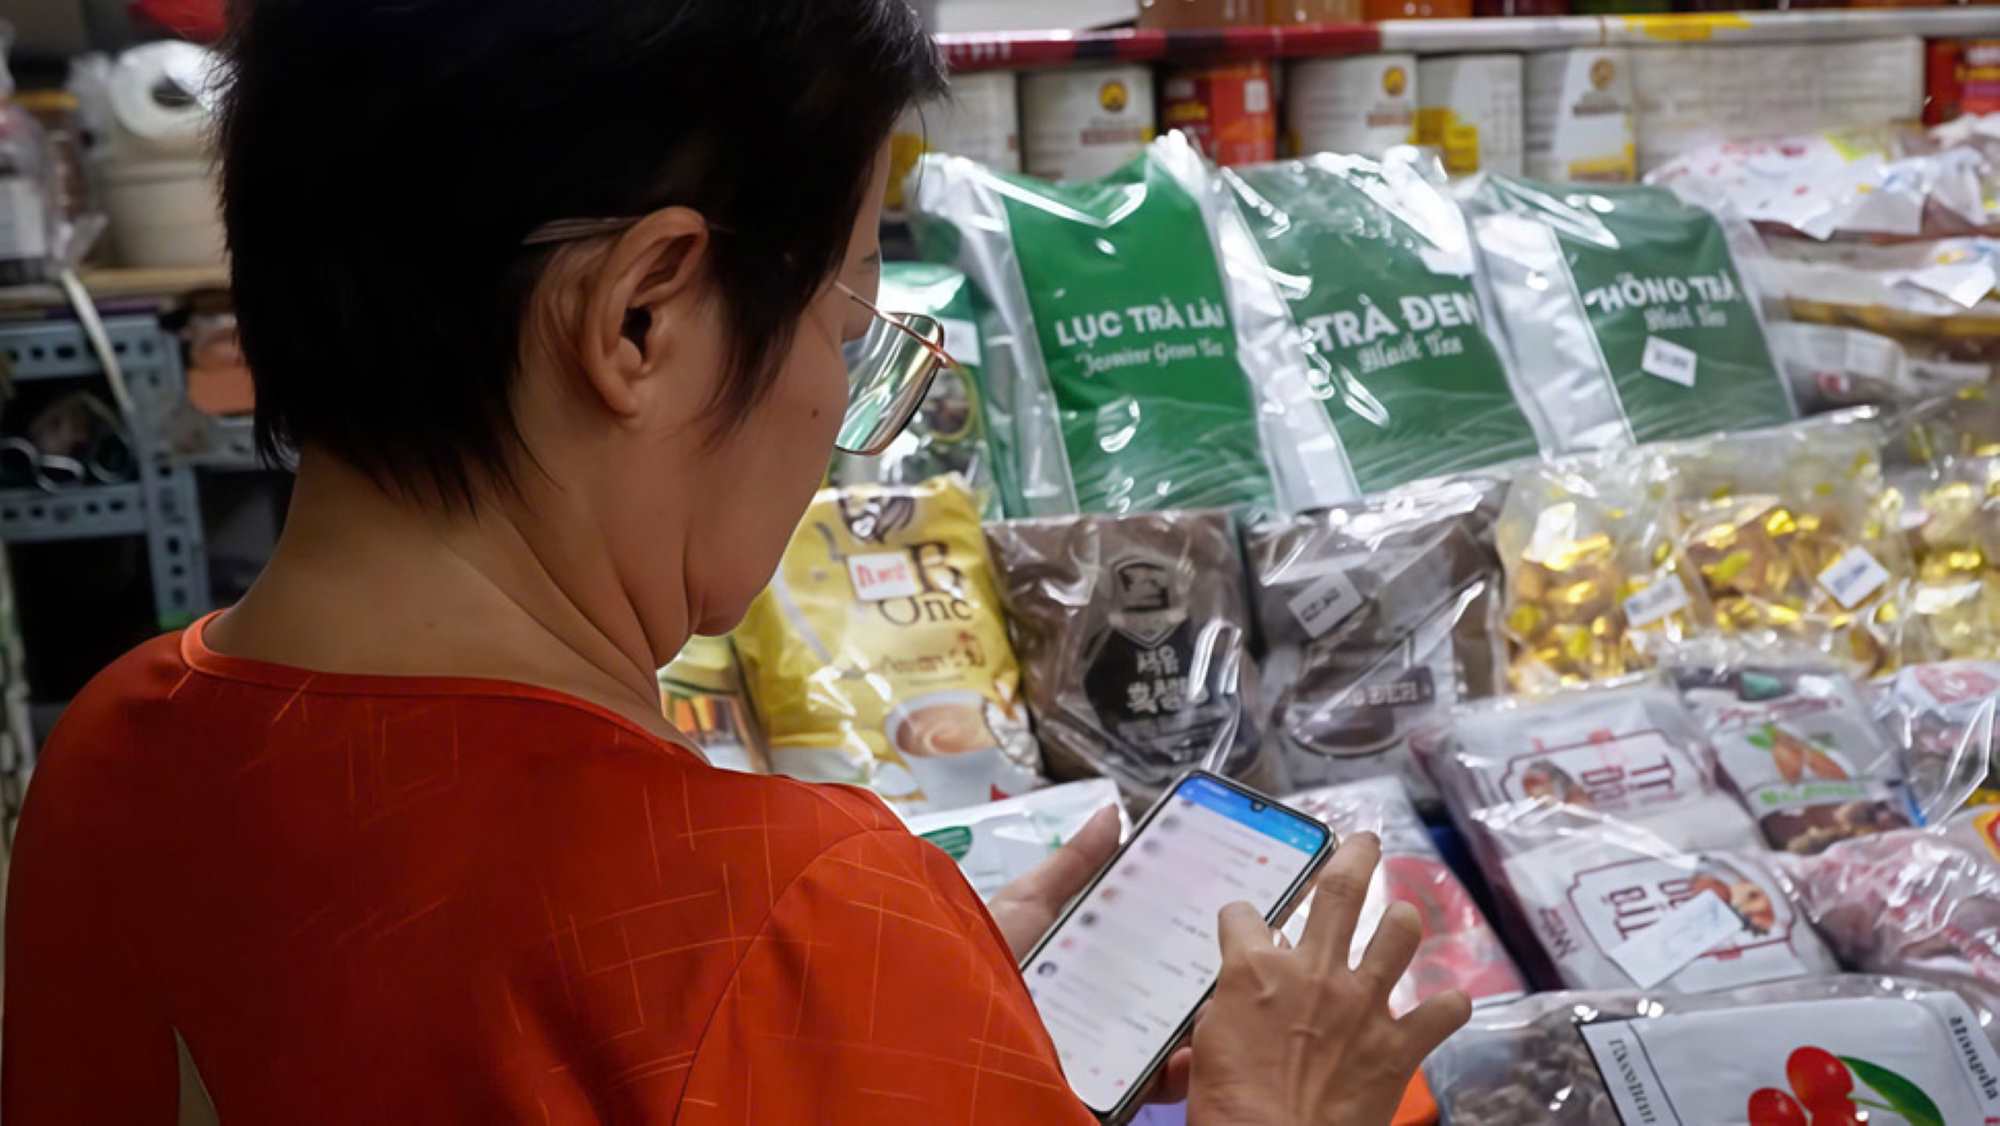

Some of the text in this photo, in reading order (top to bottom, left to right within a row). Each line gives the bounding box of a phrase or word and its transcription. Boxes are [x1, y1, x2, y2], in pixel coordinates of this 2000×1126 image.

[1056, 310, 1123, 348] LỤC
[1126, 296, 1185, 333] TRÀ
[1306, 293, 1399, 351] TRÀ
